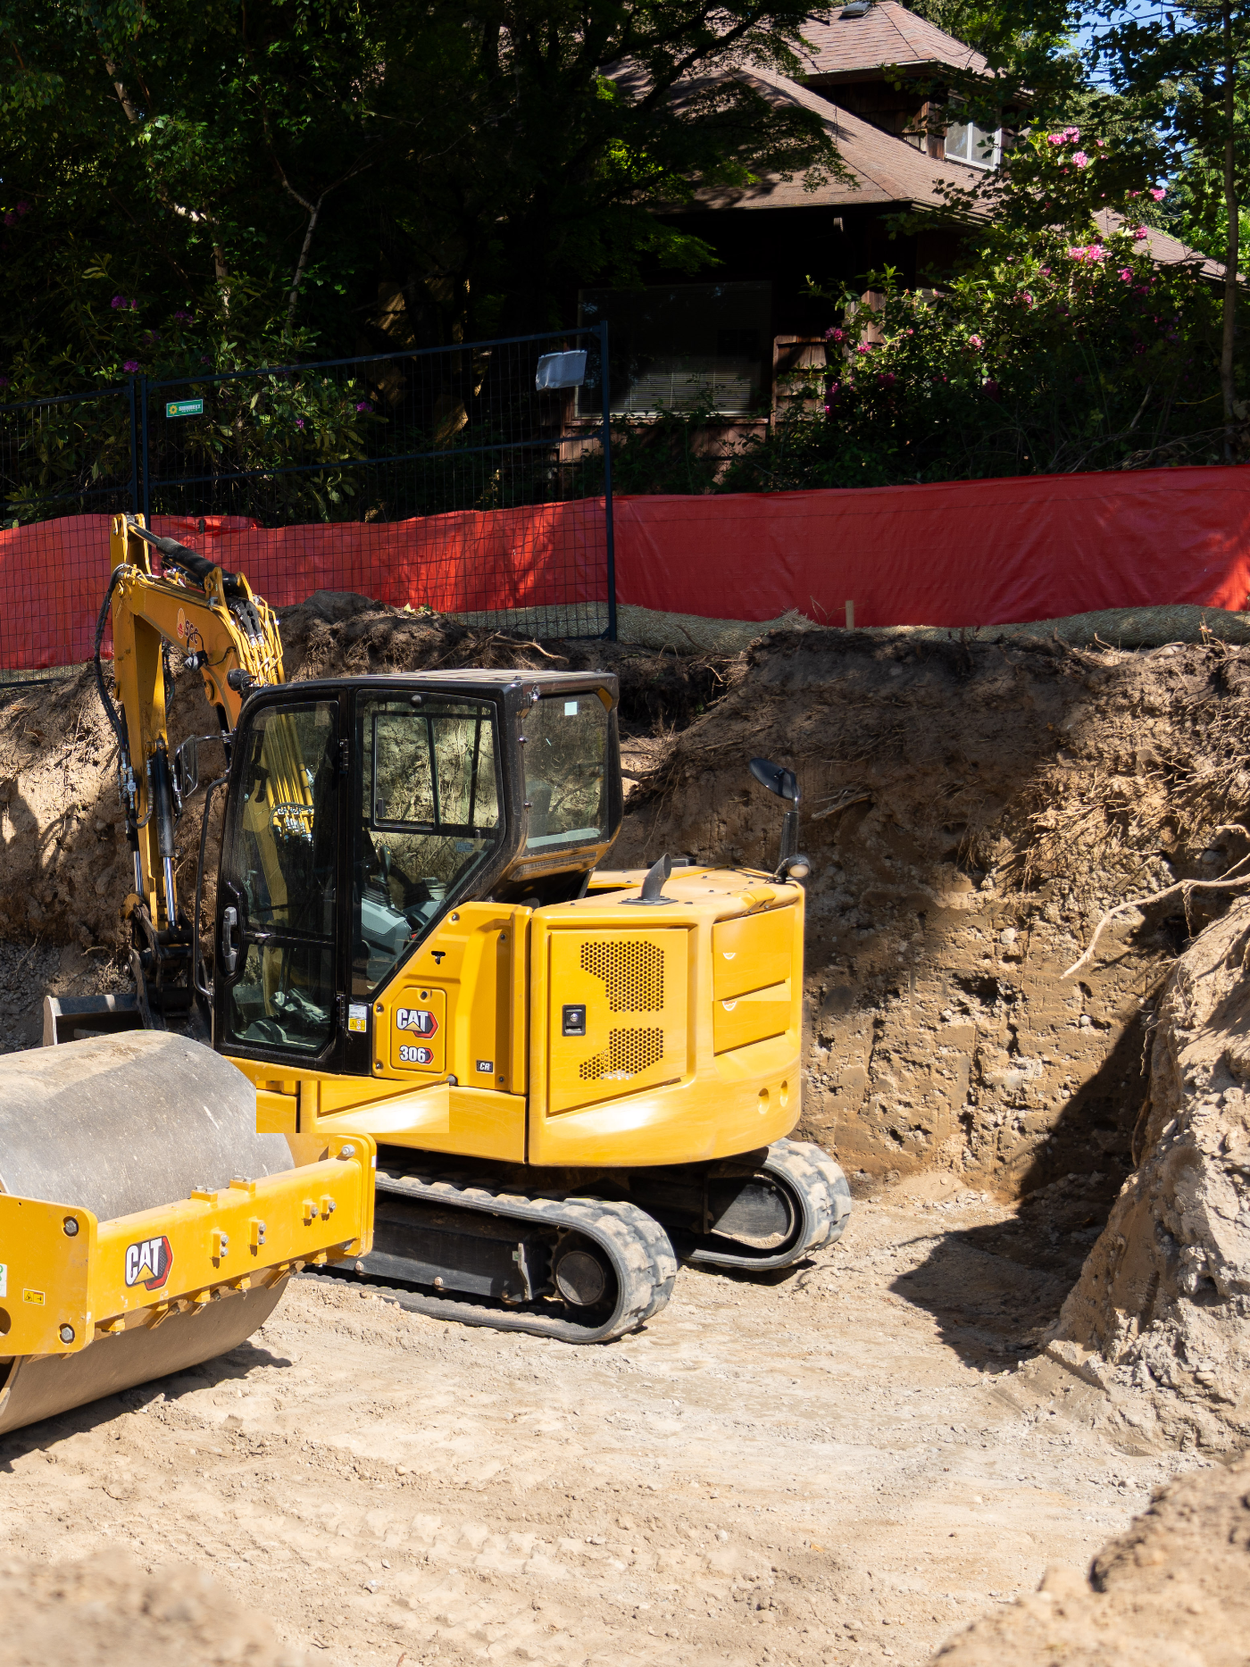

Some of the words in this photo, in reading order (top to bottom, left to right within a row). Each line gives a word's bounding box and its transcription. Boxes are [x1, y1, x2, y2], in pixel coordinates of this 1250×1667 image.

[396, 1008, 429, 1032] CAT
[399, 1045, 426, 1063] 306
[479, 1062, 491, 1071] CR
[126, 1237, 163, 1286] CAT
